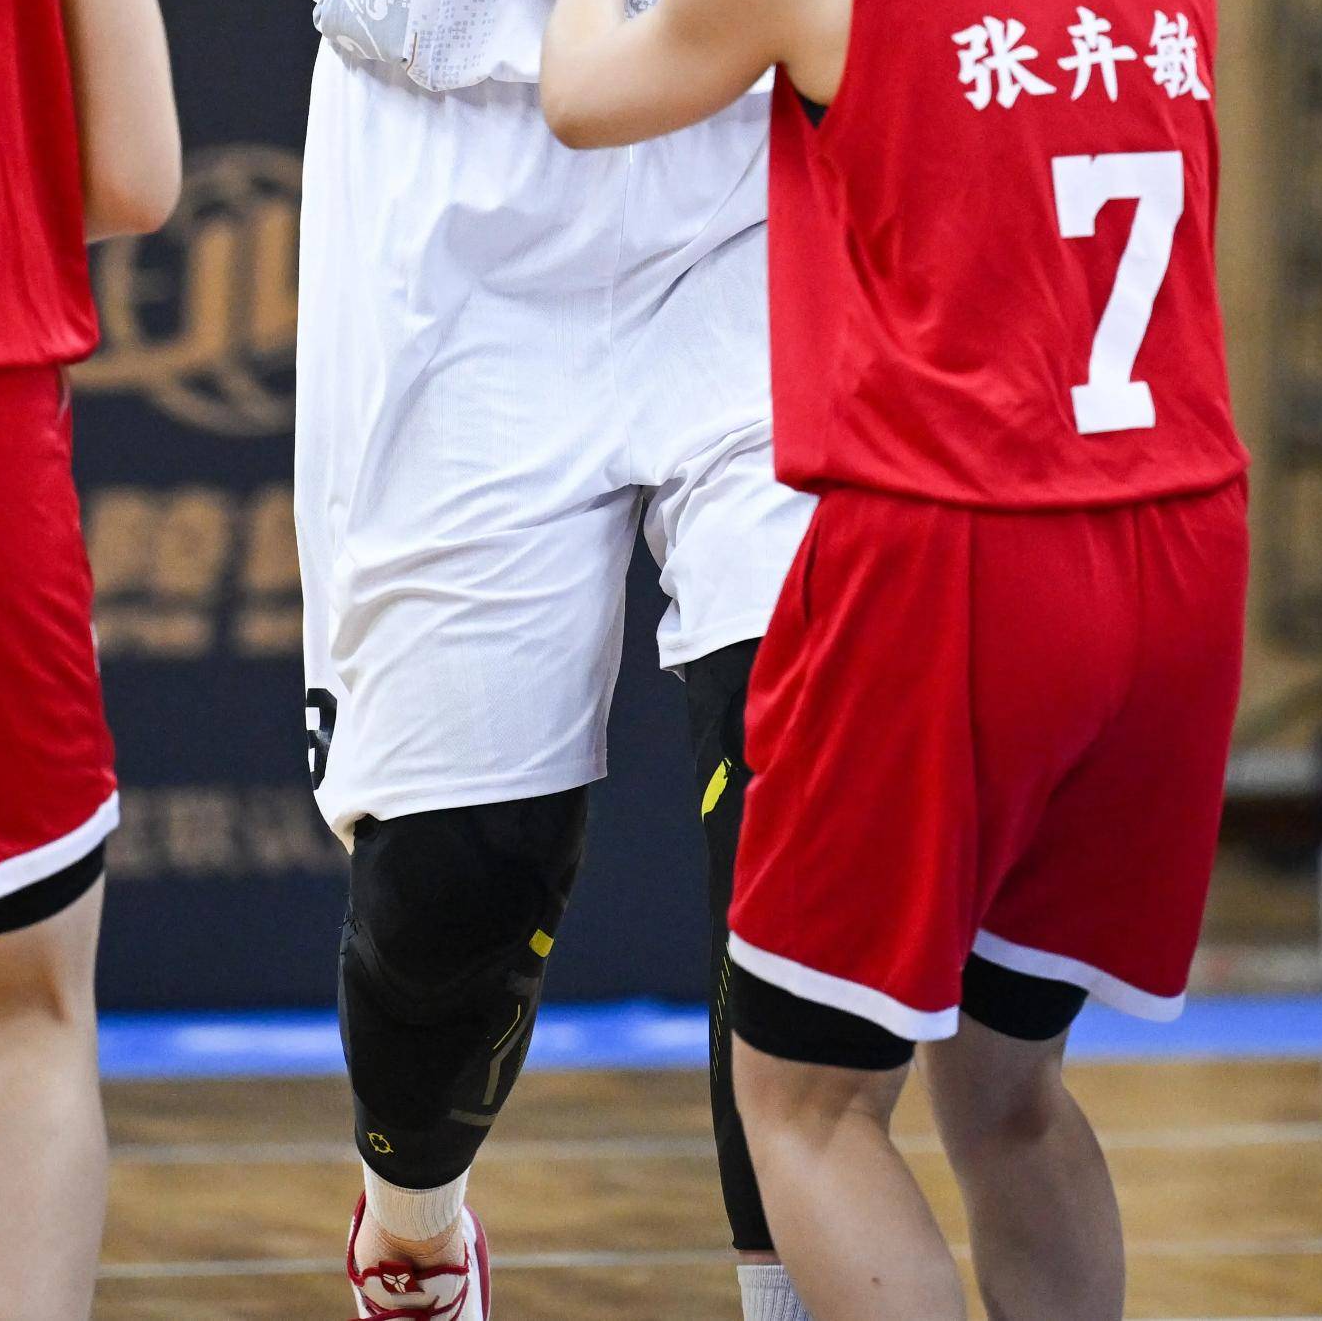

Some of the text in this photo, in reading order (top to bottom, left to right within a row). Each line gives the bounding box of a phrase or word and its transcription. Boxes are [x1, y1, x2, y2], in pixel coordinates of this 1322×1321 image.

[951, 6, 1211, 110] 张卉敏
[1051, 150, 1185, 435] 7
